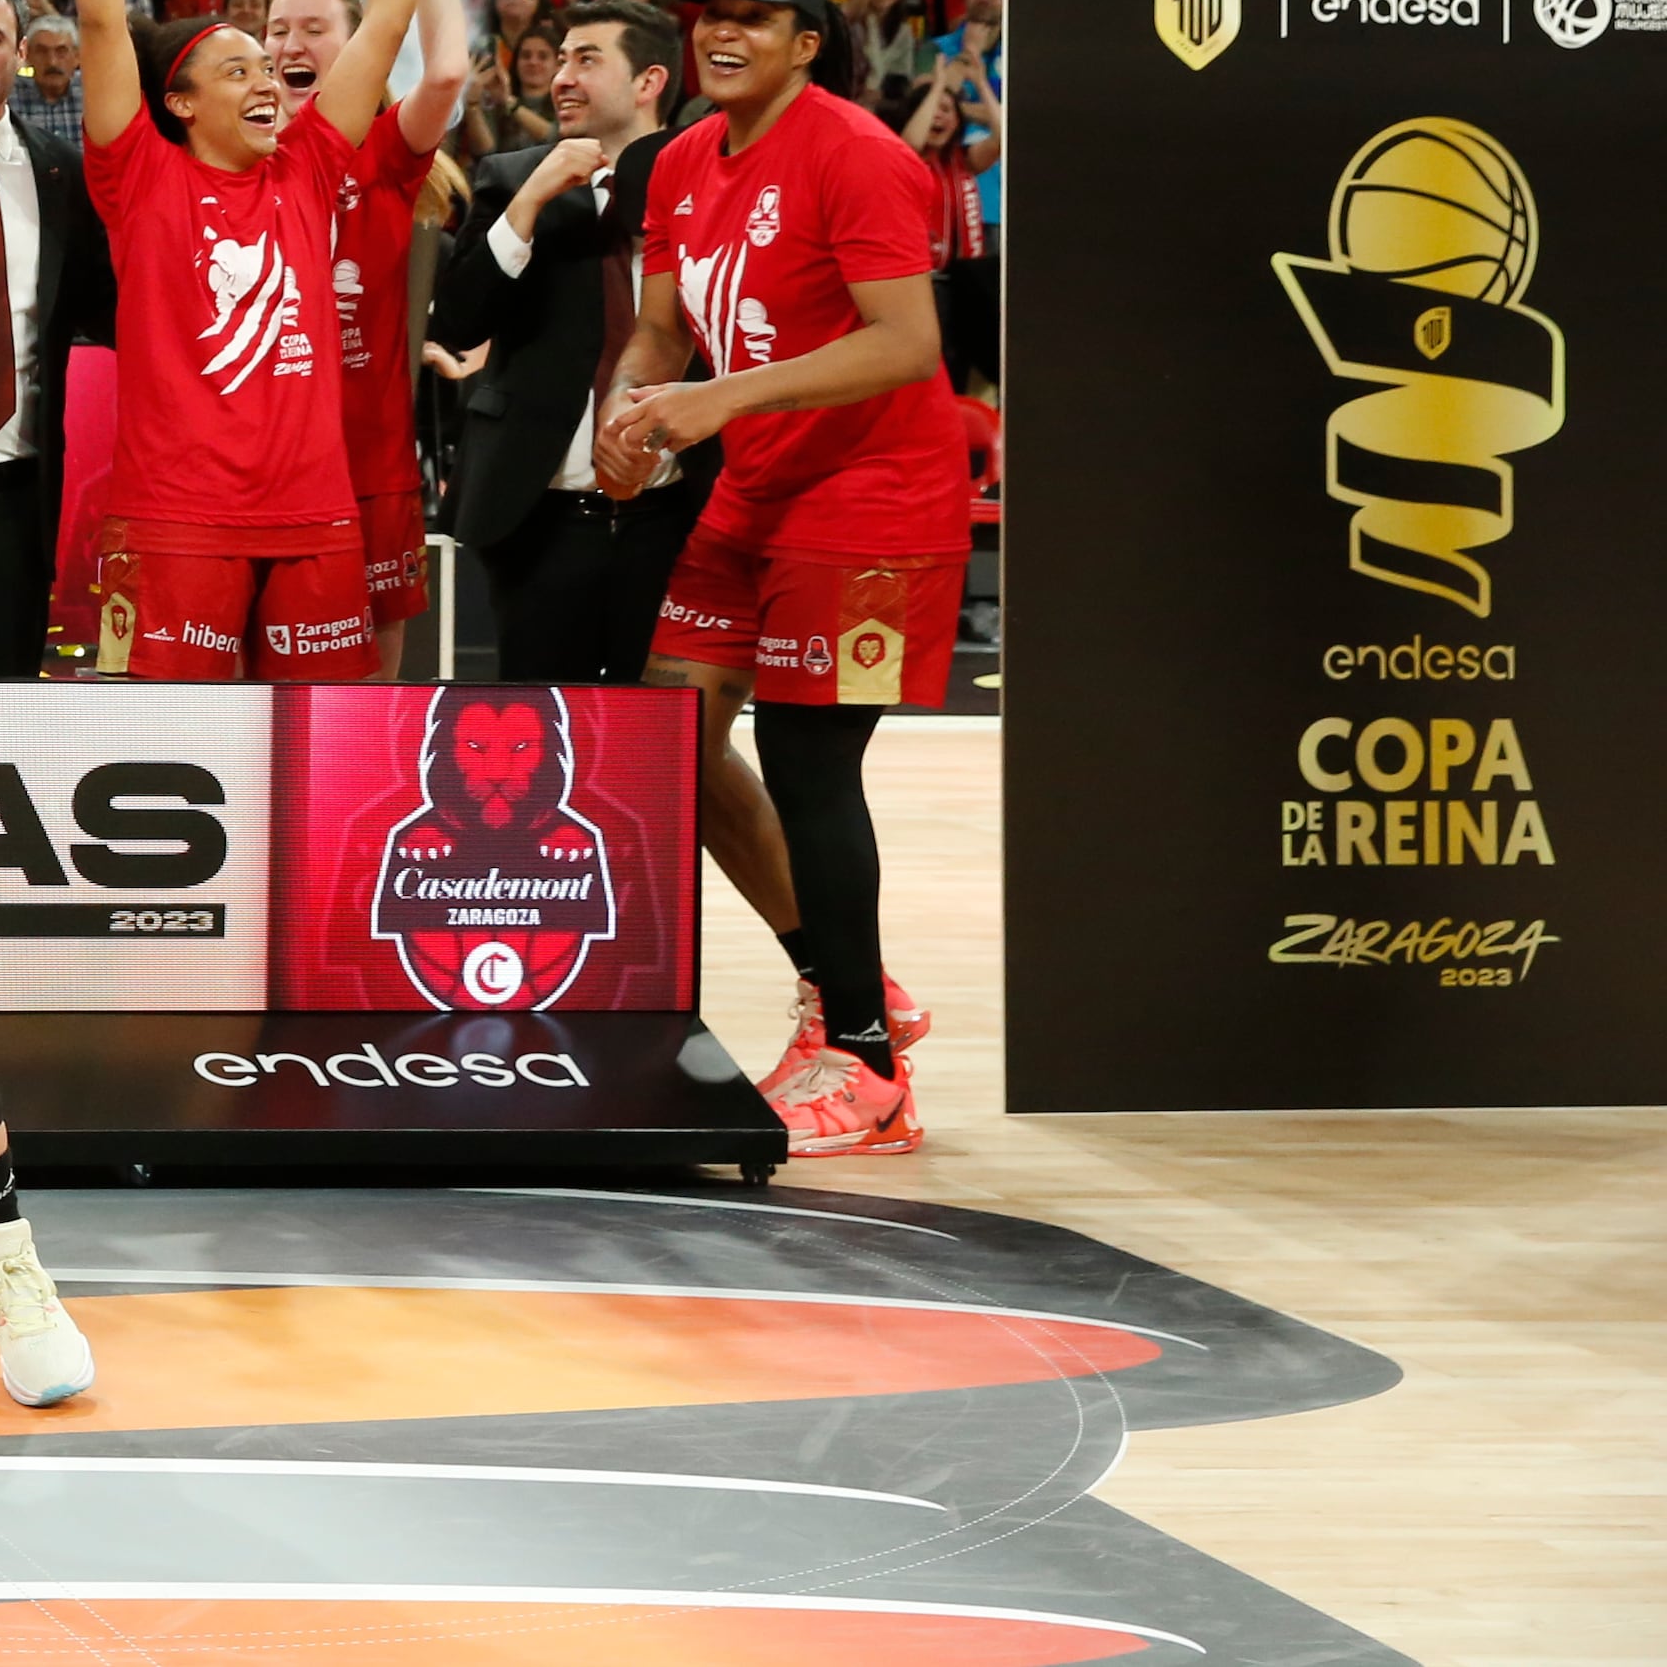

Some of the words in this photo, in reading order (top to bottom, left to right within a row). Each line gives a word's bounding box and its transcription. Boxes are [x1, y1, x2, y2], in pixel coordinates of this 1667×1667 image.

[295, 615, 361, 638] Zaragoza
[297, 631, 363, 655] DEPORTE
[1322, 634, 1516, 680] endesa
[1298, 716, 1534, 793] COPA
[1281, 801, 1324, 832] DE
[1335, 800, 1556, 866] REINA
[1281, 834, 1327, 867] LA
[393, 867, 595, 902] Casademont
[109, 910, 215, 933] 2023
[447, 908, 541, 926] ZARAGOZA
[1268, 913, 1563, 983] ZARAGOZA
[1439, 968, 1513, 987] 2023
[193, 1042, 590, 1088] endesa
